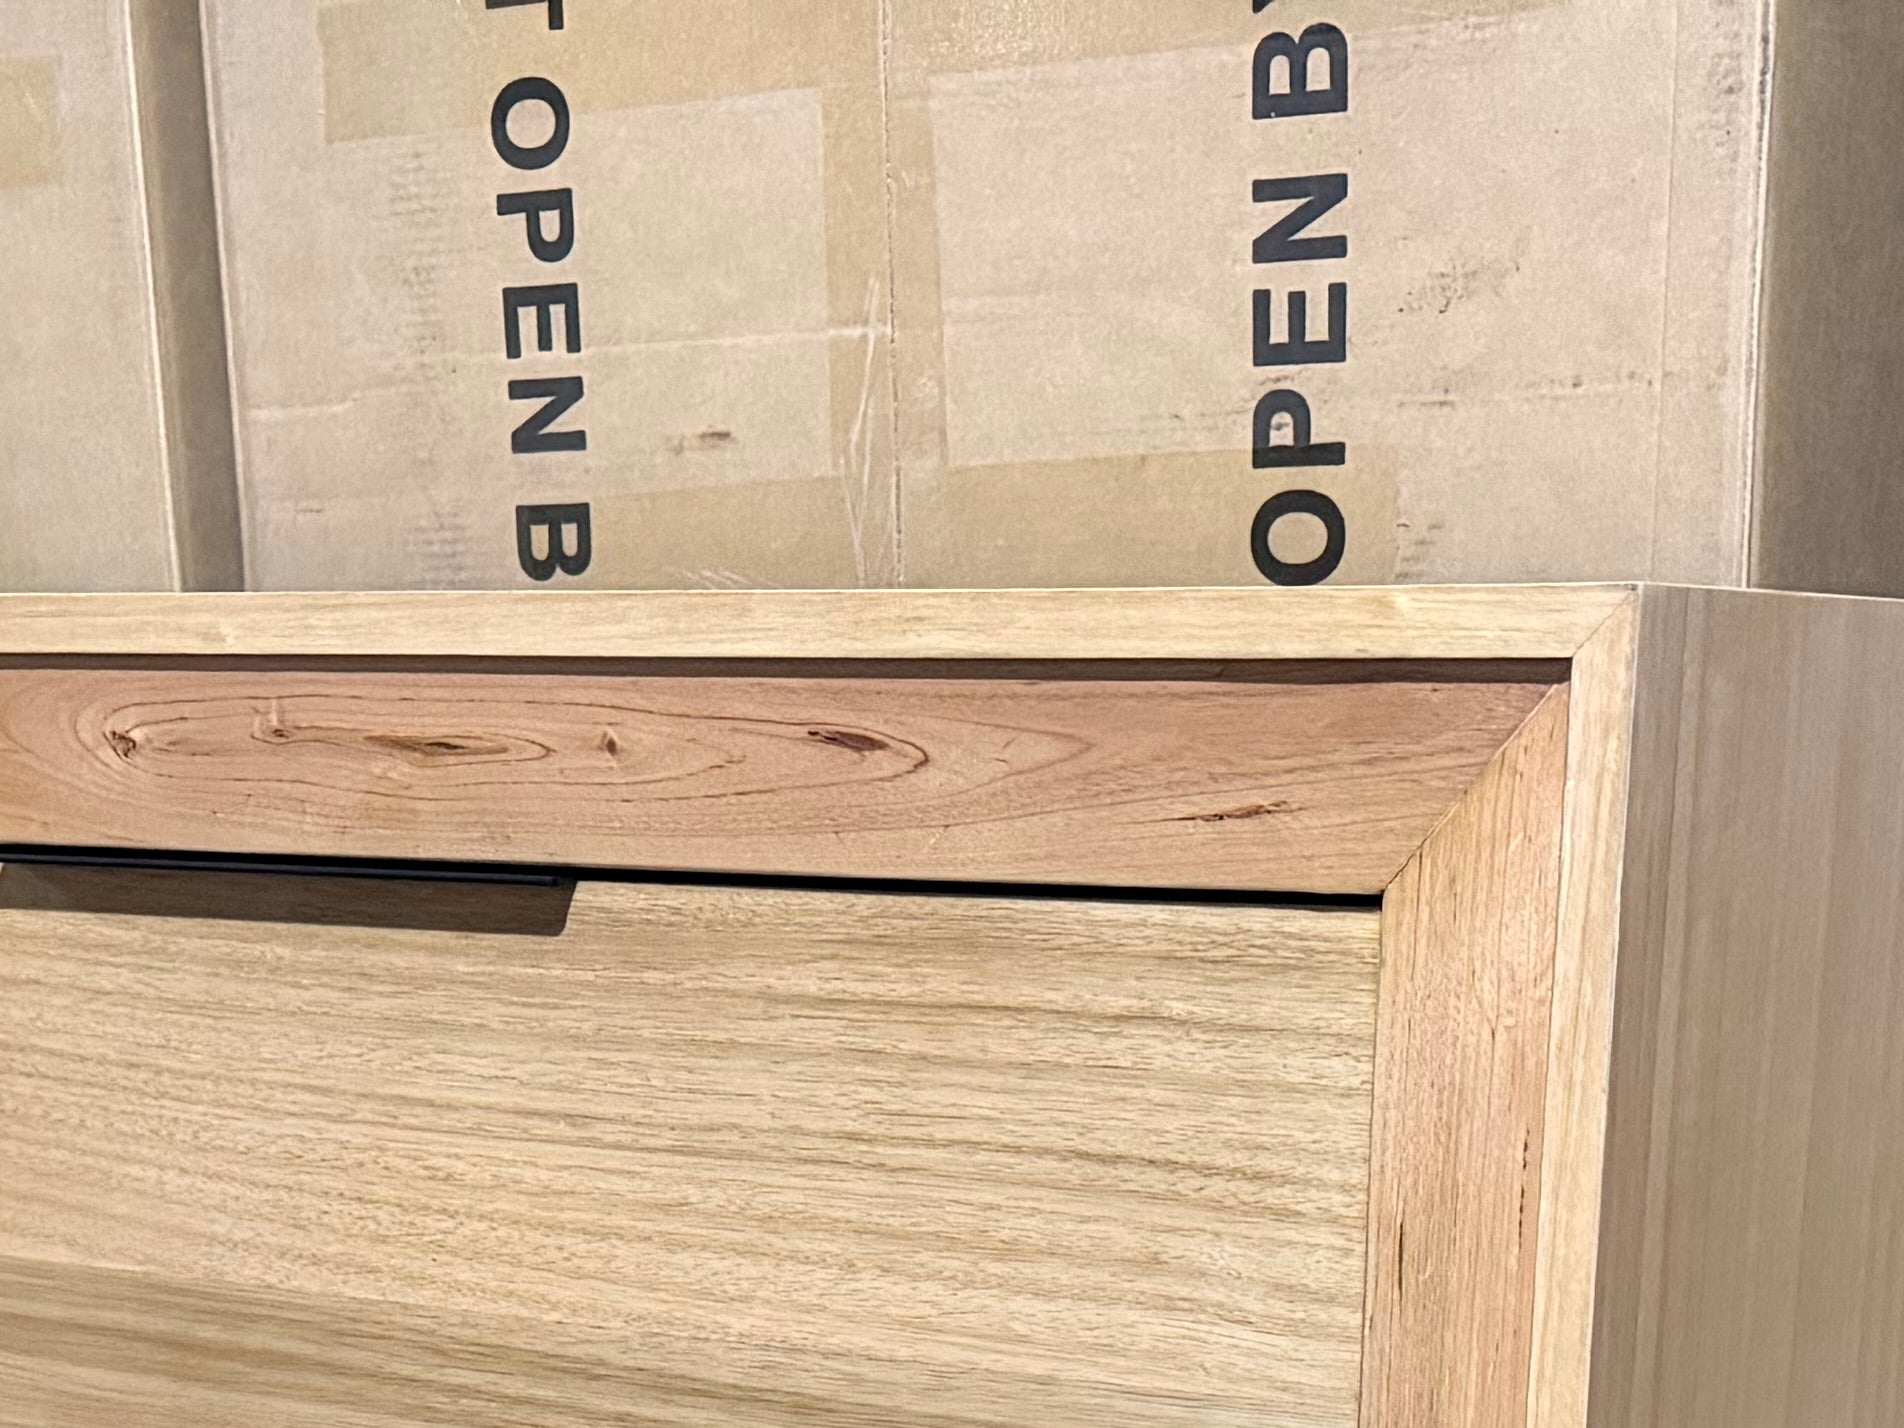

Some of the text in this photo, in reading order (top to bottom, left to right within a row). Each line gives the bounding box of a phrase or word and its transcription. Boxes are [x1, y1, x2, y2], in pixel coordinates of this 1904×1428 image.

[490, 76, 587, 454] OPEN
[1250, 0, 1349, 587] OPEN B
